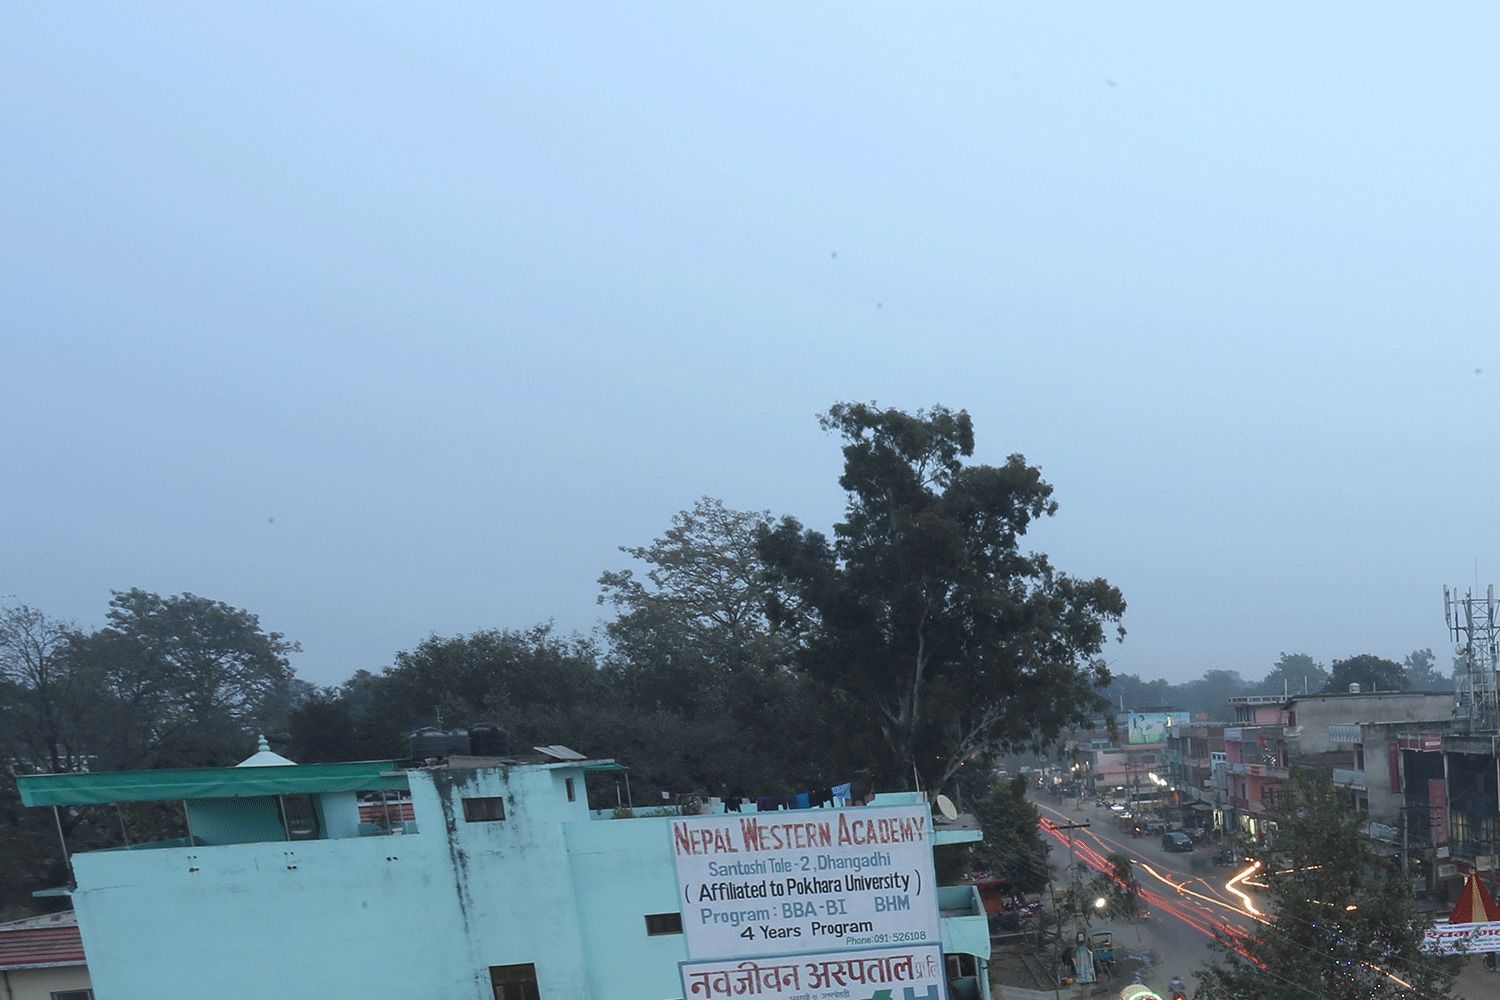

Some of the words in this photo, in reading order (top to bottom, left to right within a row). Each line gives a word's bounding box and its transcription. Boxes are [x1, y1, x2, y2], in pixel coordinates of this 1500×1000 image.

[674, 820, 738, 855] NEPAL
[740, 817, 831, 852] WESTERN
[838, 813, 925, 846] ACADEMY
[709, 859, 767, 877] Santoshi
[699, 880, 767, 902] Affiliated
[770, 881, 784, 897] to
[787, 876, 841, 896] Pokhara
[846, 872, 909, 892] University
[874, 896, 910, 913] BHM
[740, 926, 755, 940] 4
[760, 923, 801, 939] Years
[811, 920, 873, 938] Program
[689, 962, 800, 999] नवजीवन
[805, 954, 915, 989] अस्पताल
